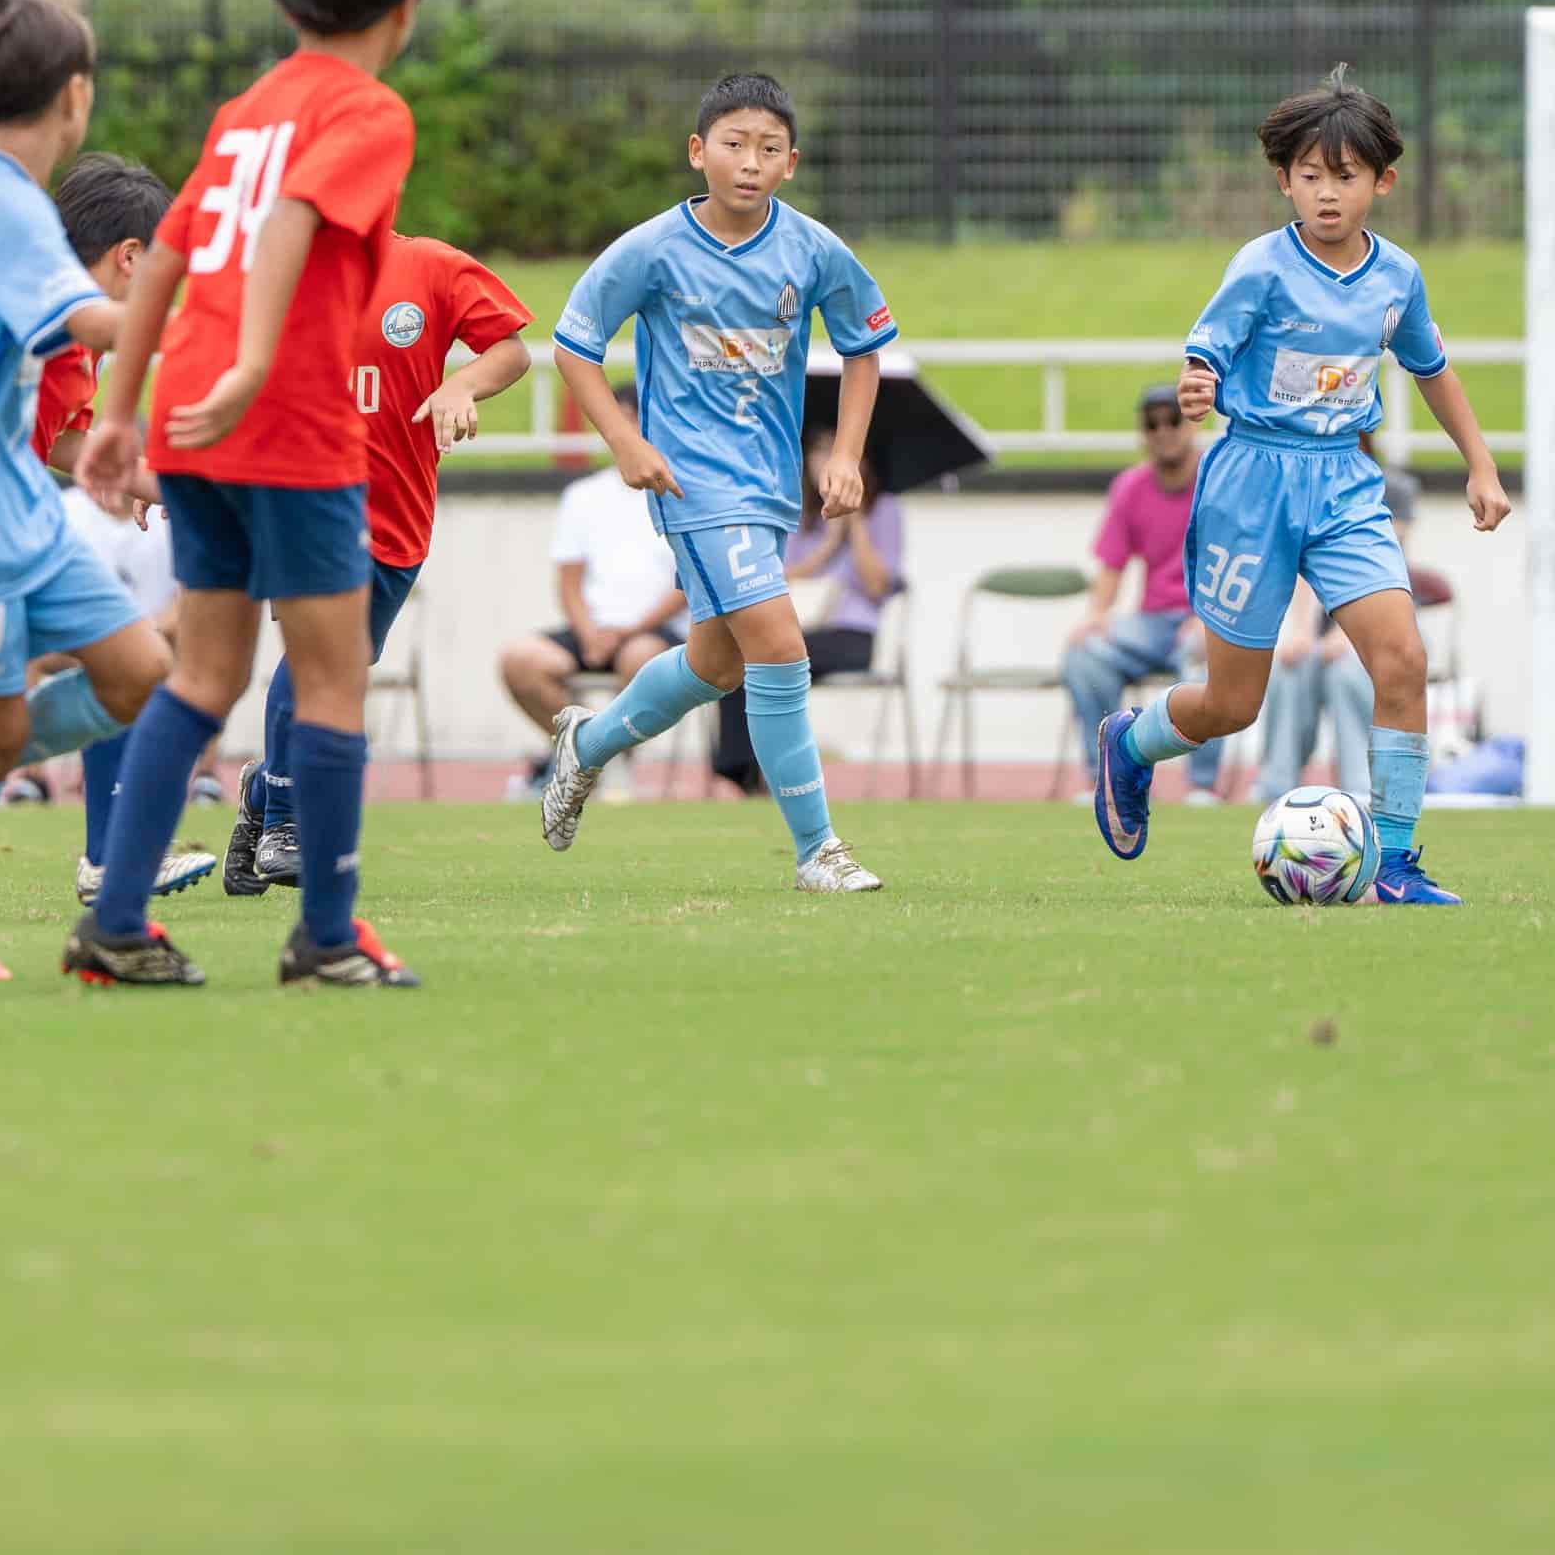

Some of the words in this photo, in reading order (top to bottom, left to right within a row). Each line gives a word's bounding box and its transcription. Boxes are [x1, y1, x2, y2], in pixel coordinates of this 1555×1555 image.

[189, 120, 295, 274] 34
[347, 365, 381, 414] 0
[725, 524, 758, 580] 2
[1197, 543, 1262, 613] 36
